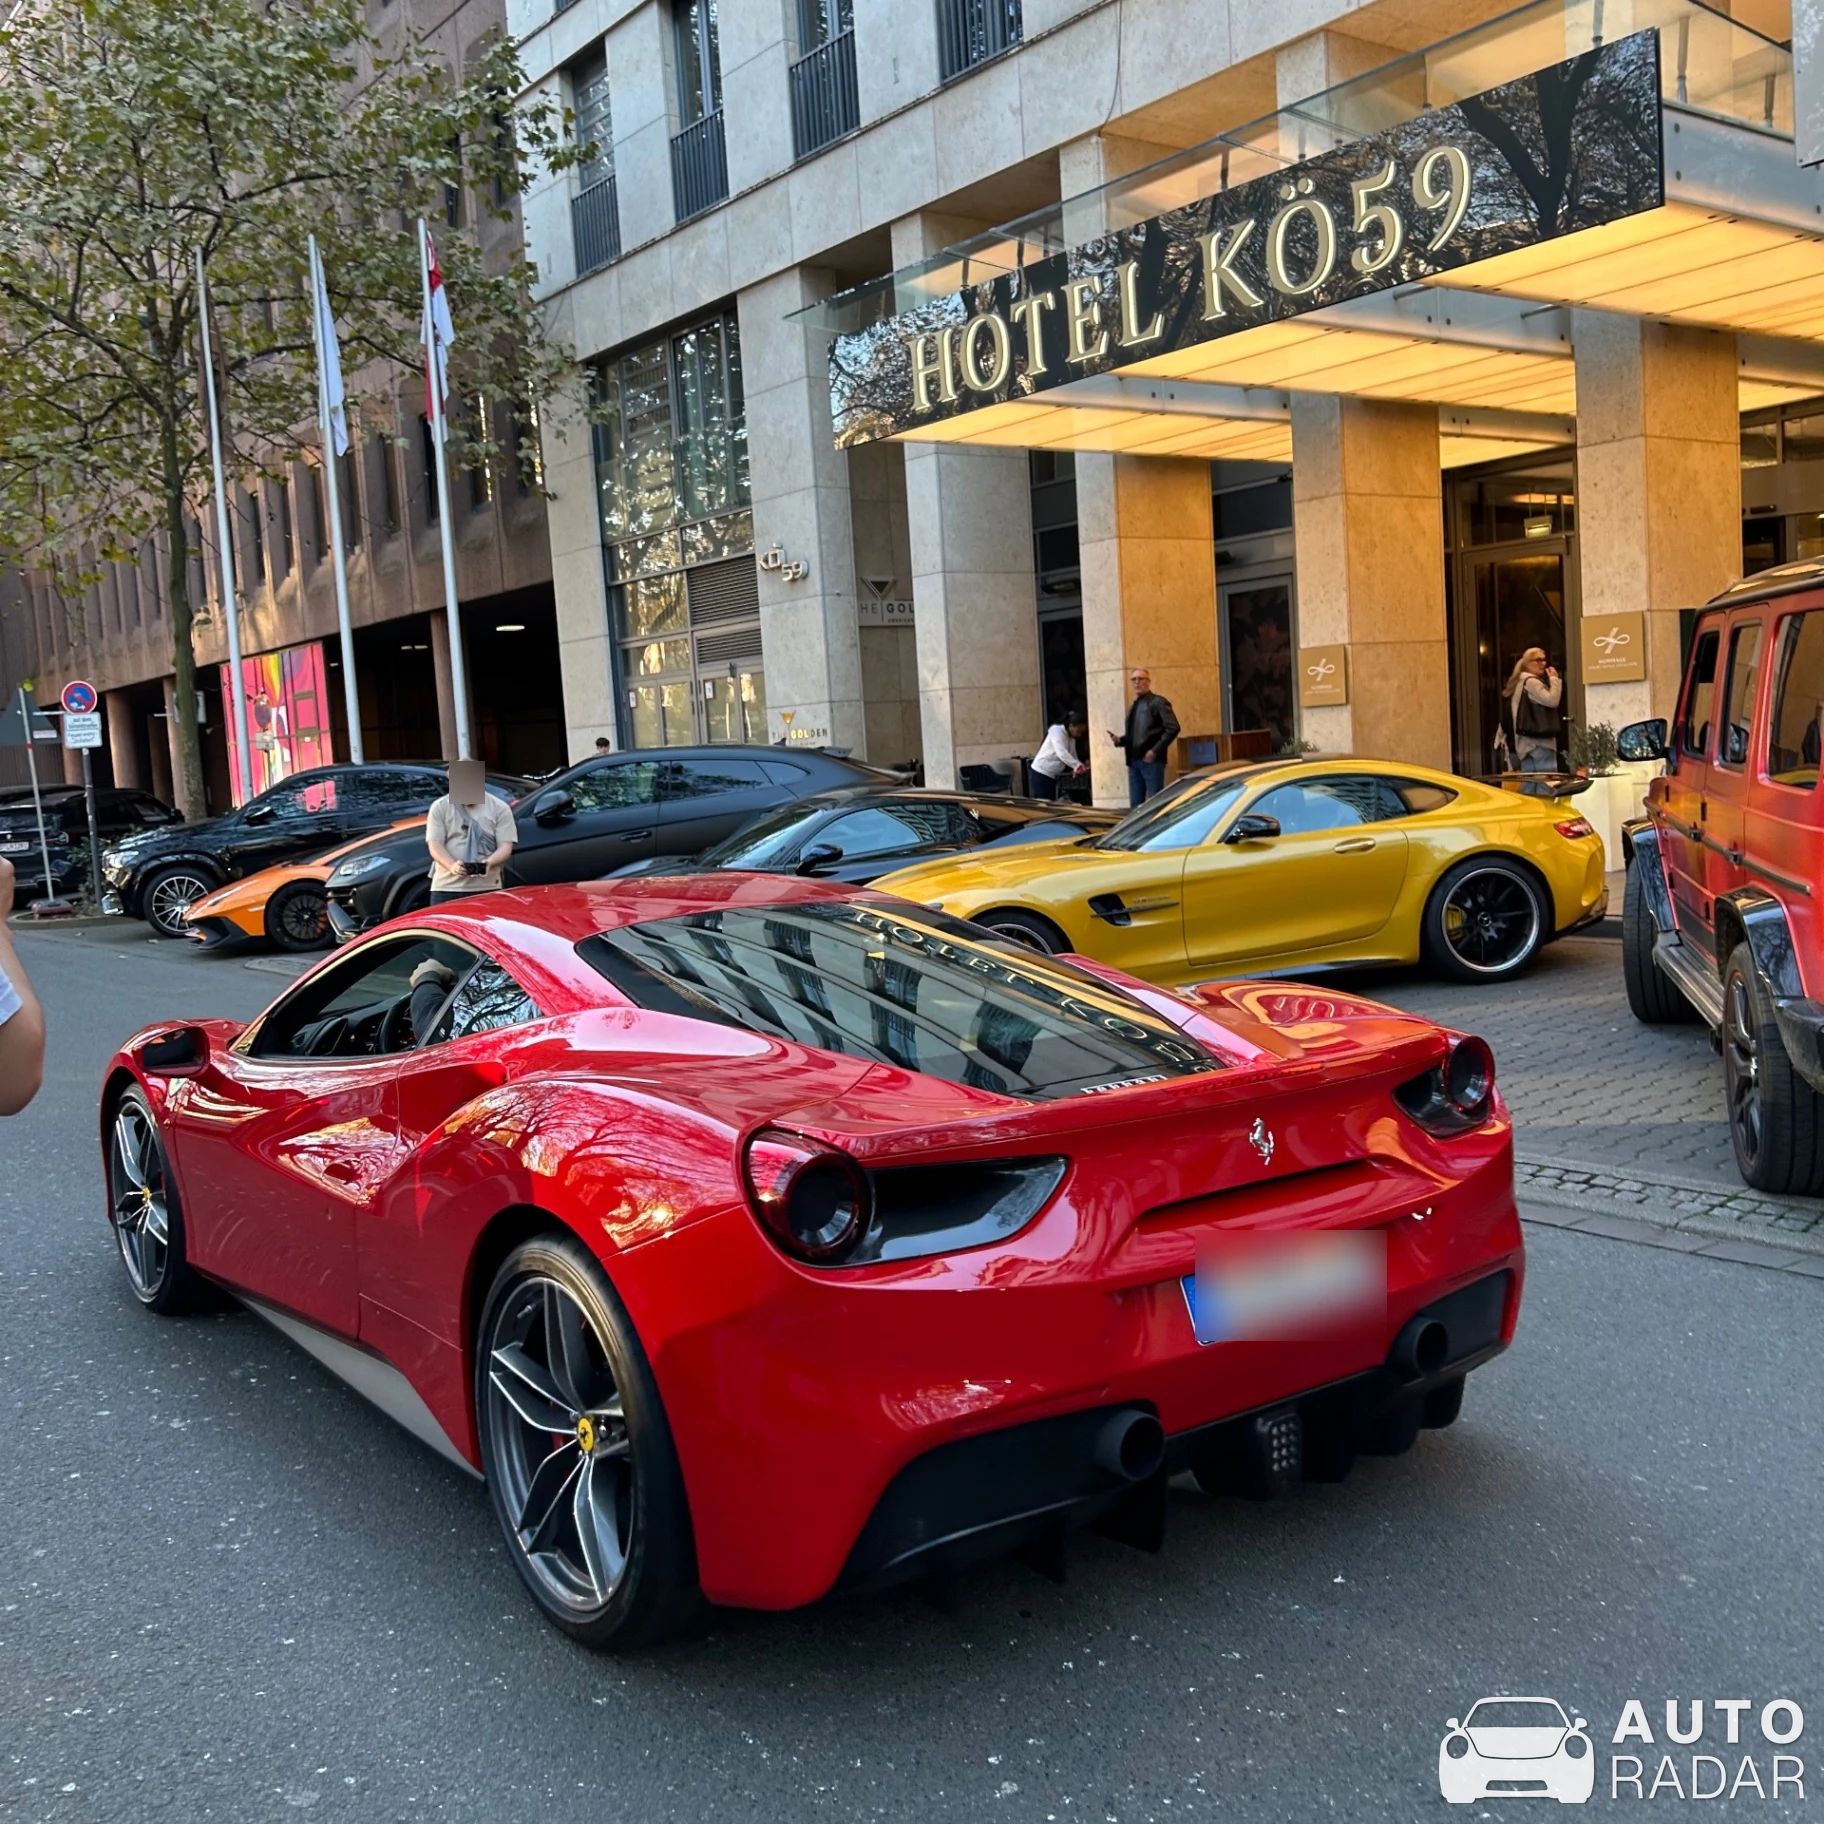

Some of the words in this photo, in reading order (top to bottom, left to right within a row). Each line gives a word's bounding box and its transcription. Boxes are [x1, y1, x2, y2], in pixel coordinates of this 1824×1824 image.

[908, 261, 1164, 410] HOTEL
[1200, 146, 1472, 321] KÖ59
[859, 602, 878, 614] HE
[886, 602, 914, 614] GOL
[790, 728, 828, 740] GOLDEN
